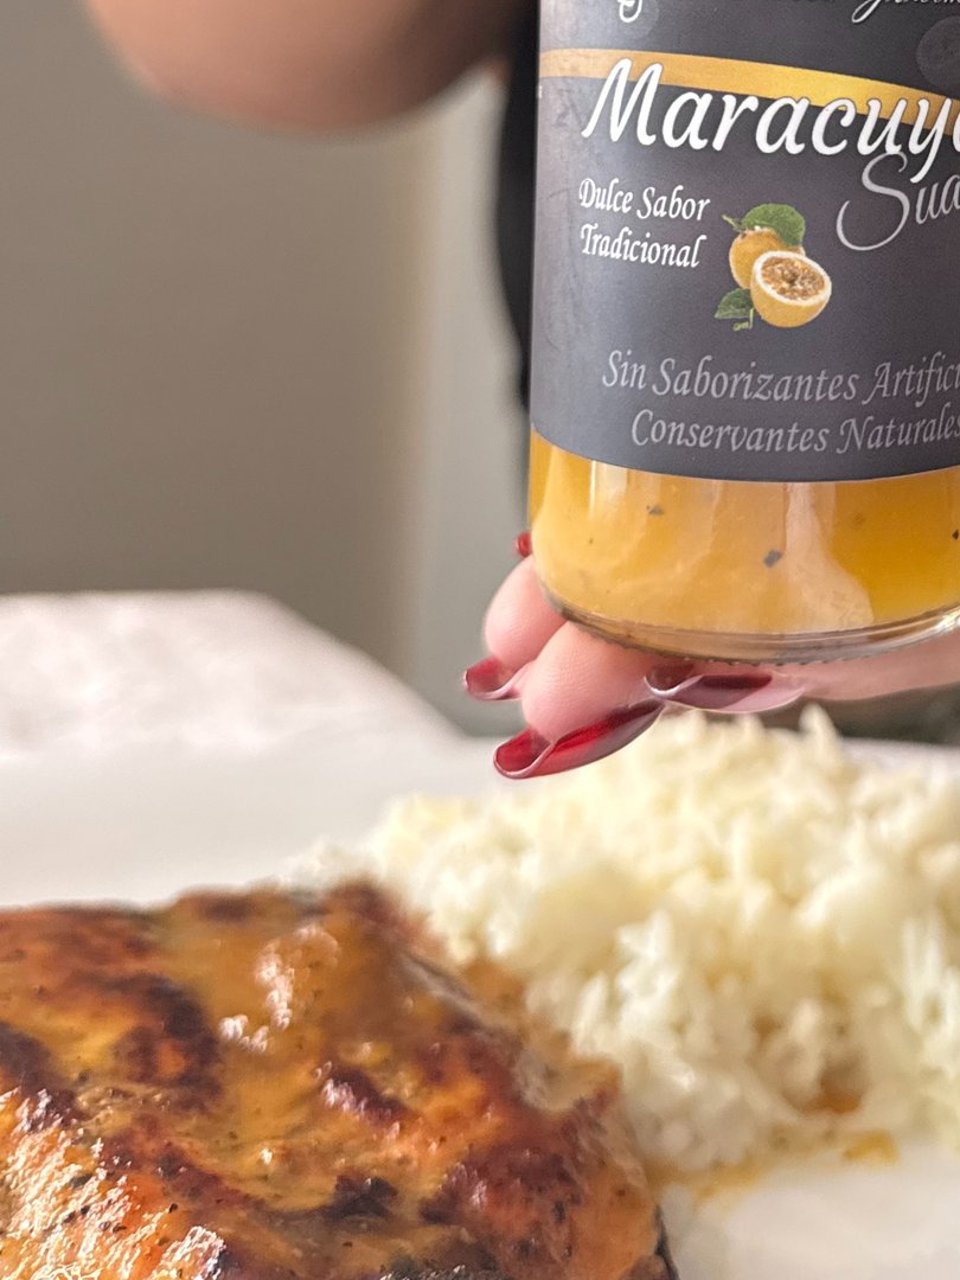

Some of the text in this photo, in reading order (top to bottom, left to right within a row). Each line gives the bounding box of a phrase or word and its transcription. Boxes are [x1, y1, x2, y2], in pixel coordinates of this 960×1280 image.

[579, 177, 711, 221] Dulce Sabor
[580, 222, 707, 269] Tradicional
[602, 349, 647, 390] Sin
[652, 355, 859, 402] Saborizantes
[631, 409, 830, 453] Conservantes
